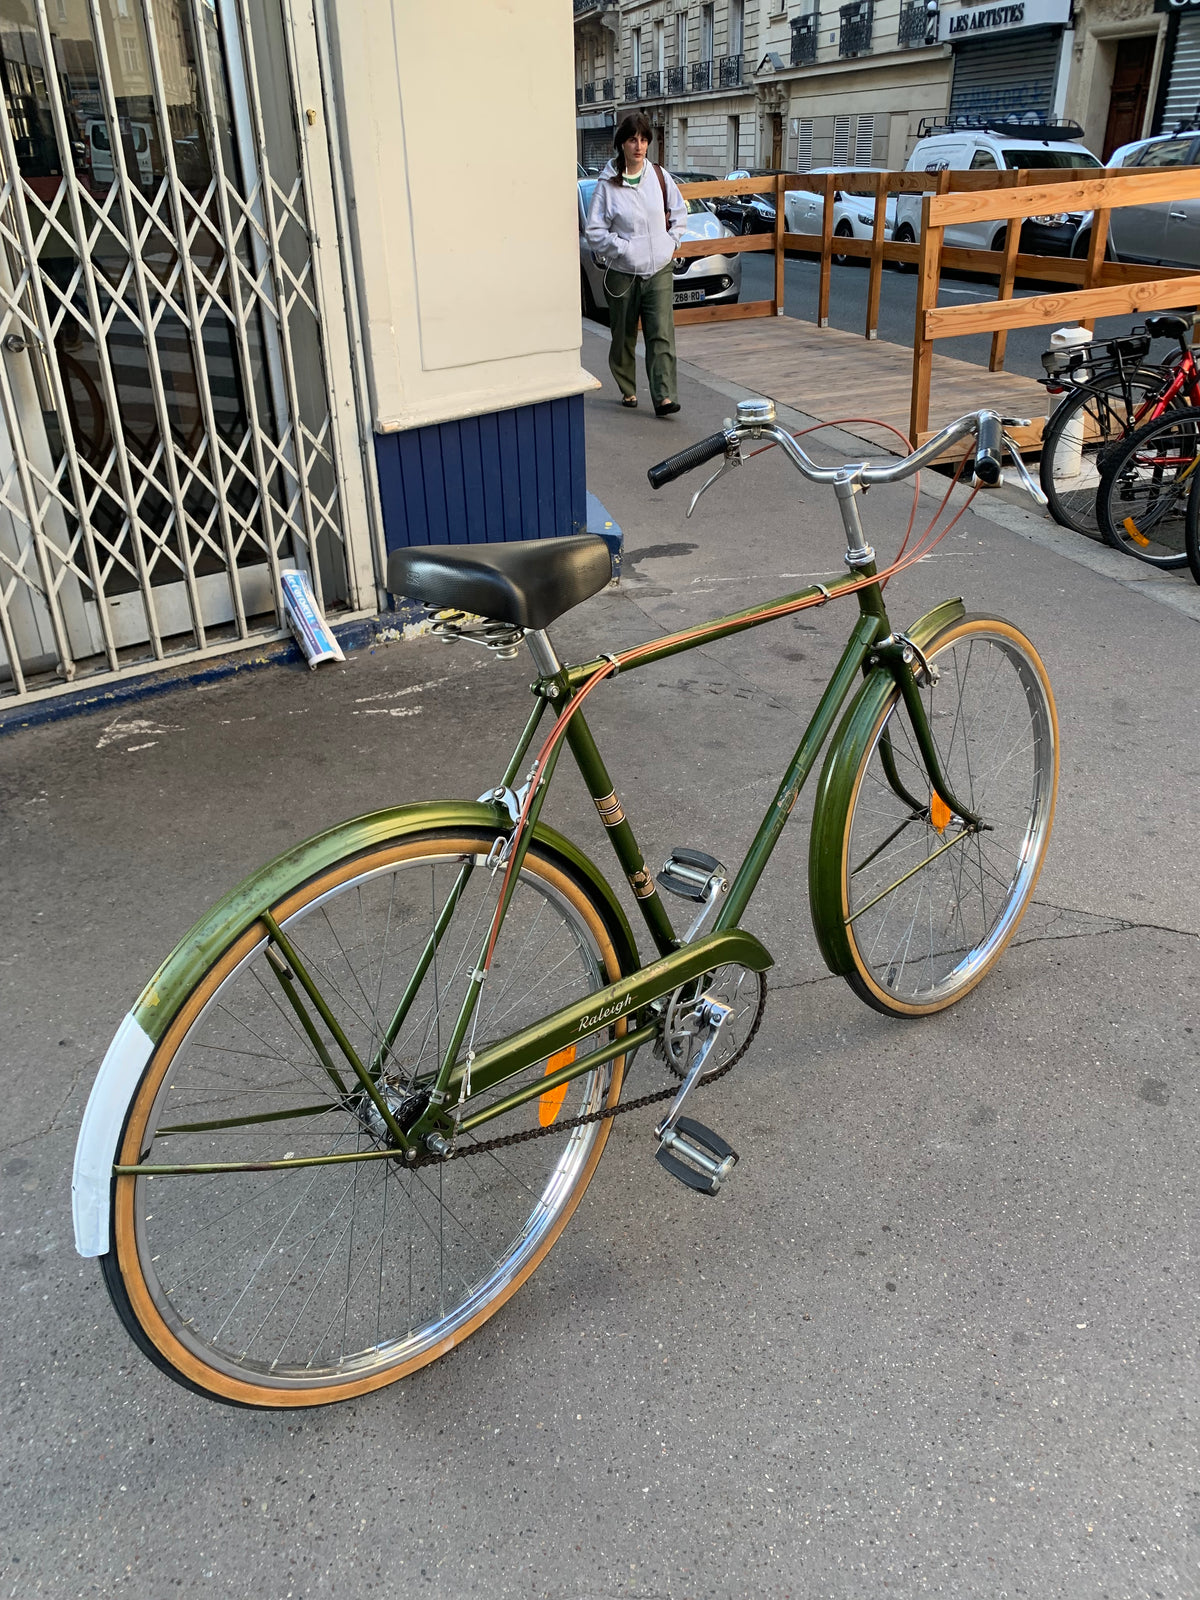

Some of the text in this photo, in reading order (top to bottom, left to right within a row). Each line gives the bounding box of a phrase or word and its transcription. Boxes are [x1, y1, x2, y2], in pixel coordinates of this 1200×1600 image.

[949, 2, 1025, 33] LES ARTISTES
[578, 993, 632, 1032] Raleigh
